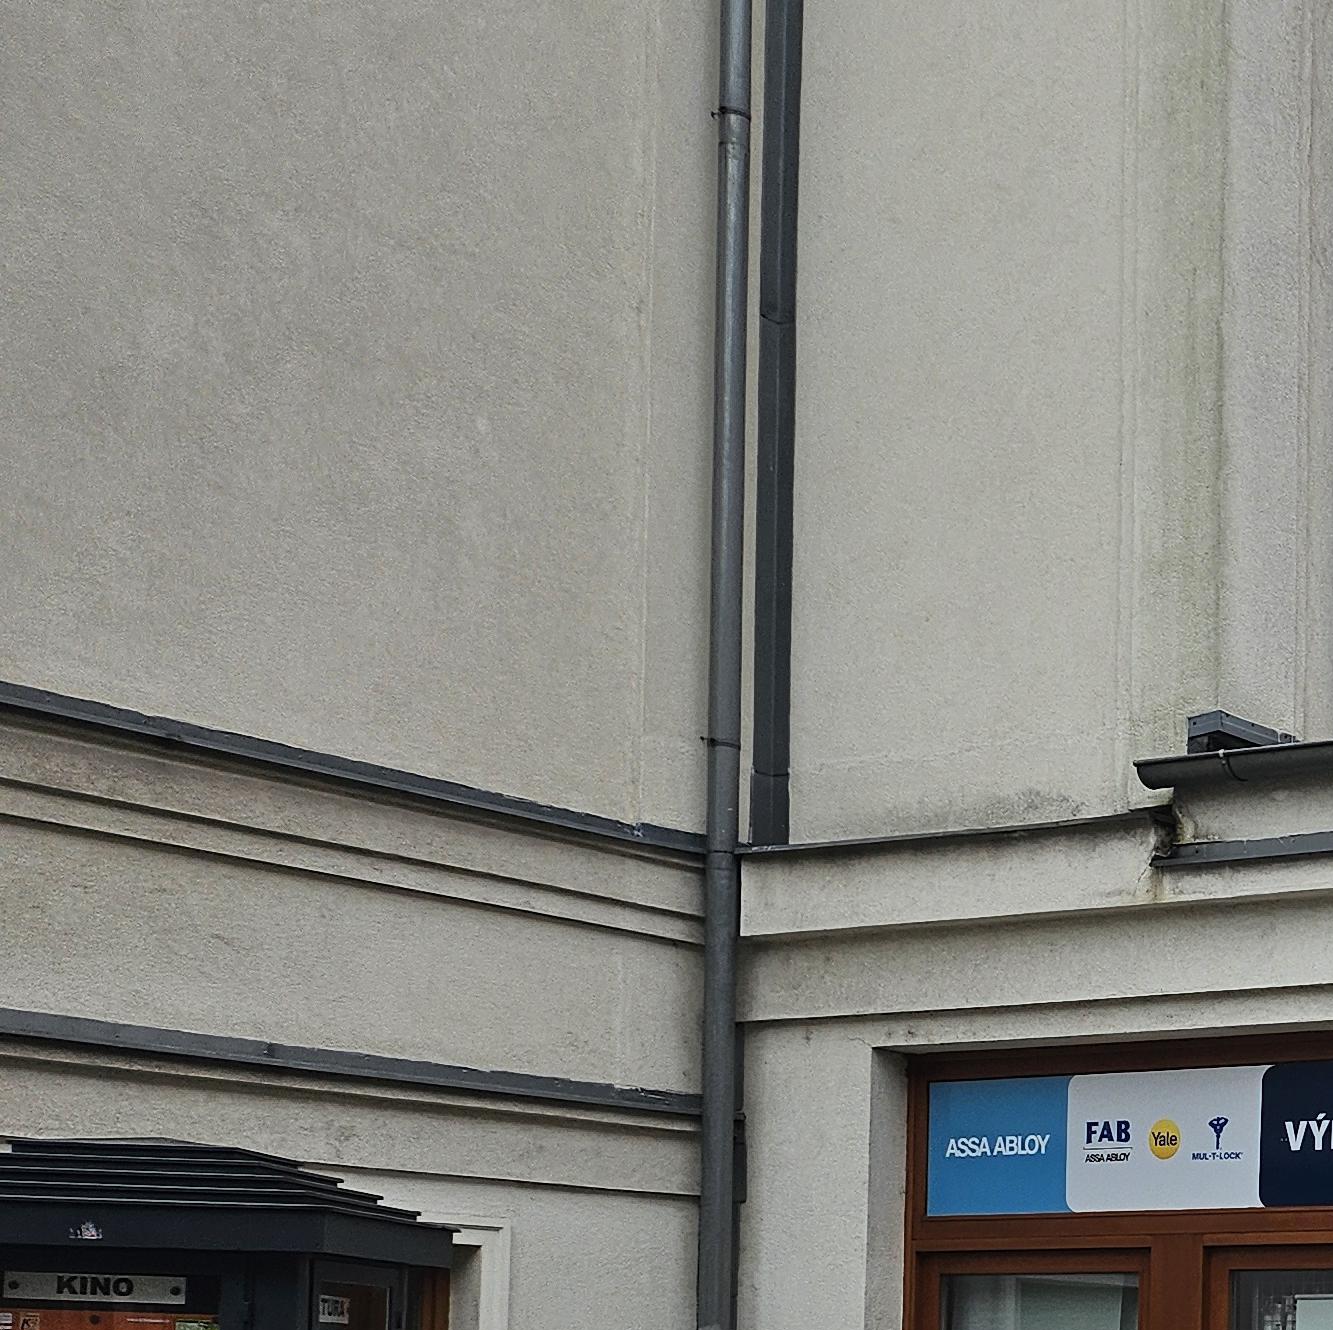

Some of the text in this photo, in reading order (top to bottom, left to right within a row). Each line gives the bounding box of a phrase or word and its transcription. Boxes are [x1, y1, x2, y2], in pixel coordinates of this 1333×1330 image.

[1086, 1119, 1131, 1144] FAB
[1151, 1132, 1178, 1148] Yale
[945, 1134, 1050, 1158] ASSA ABLOY
[1085, 1153, 1105, 1163] ASSA
[1192, 1151, 1242, 1161] MUL-T-LOCK
[56, 1275, 134, 1297] KINO
